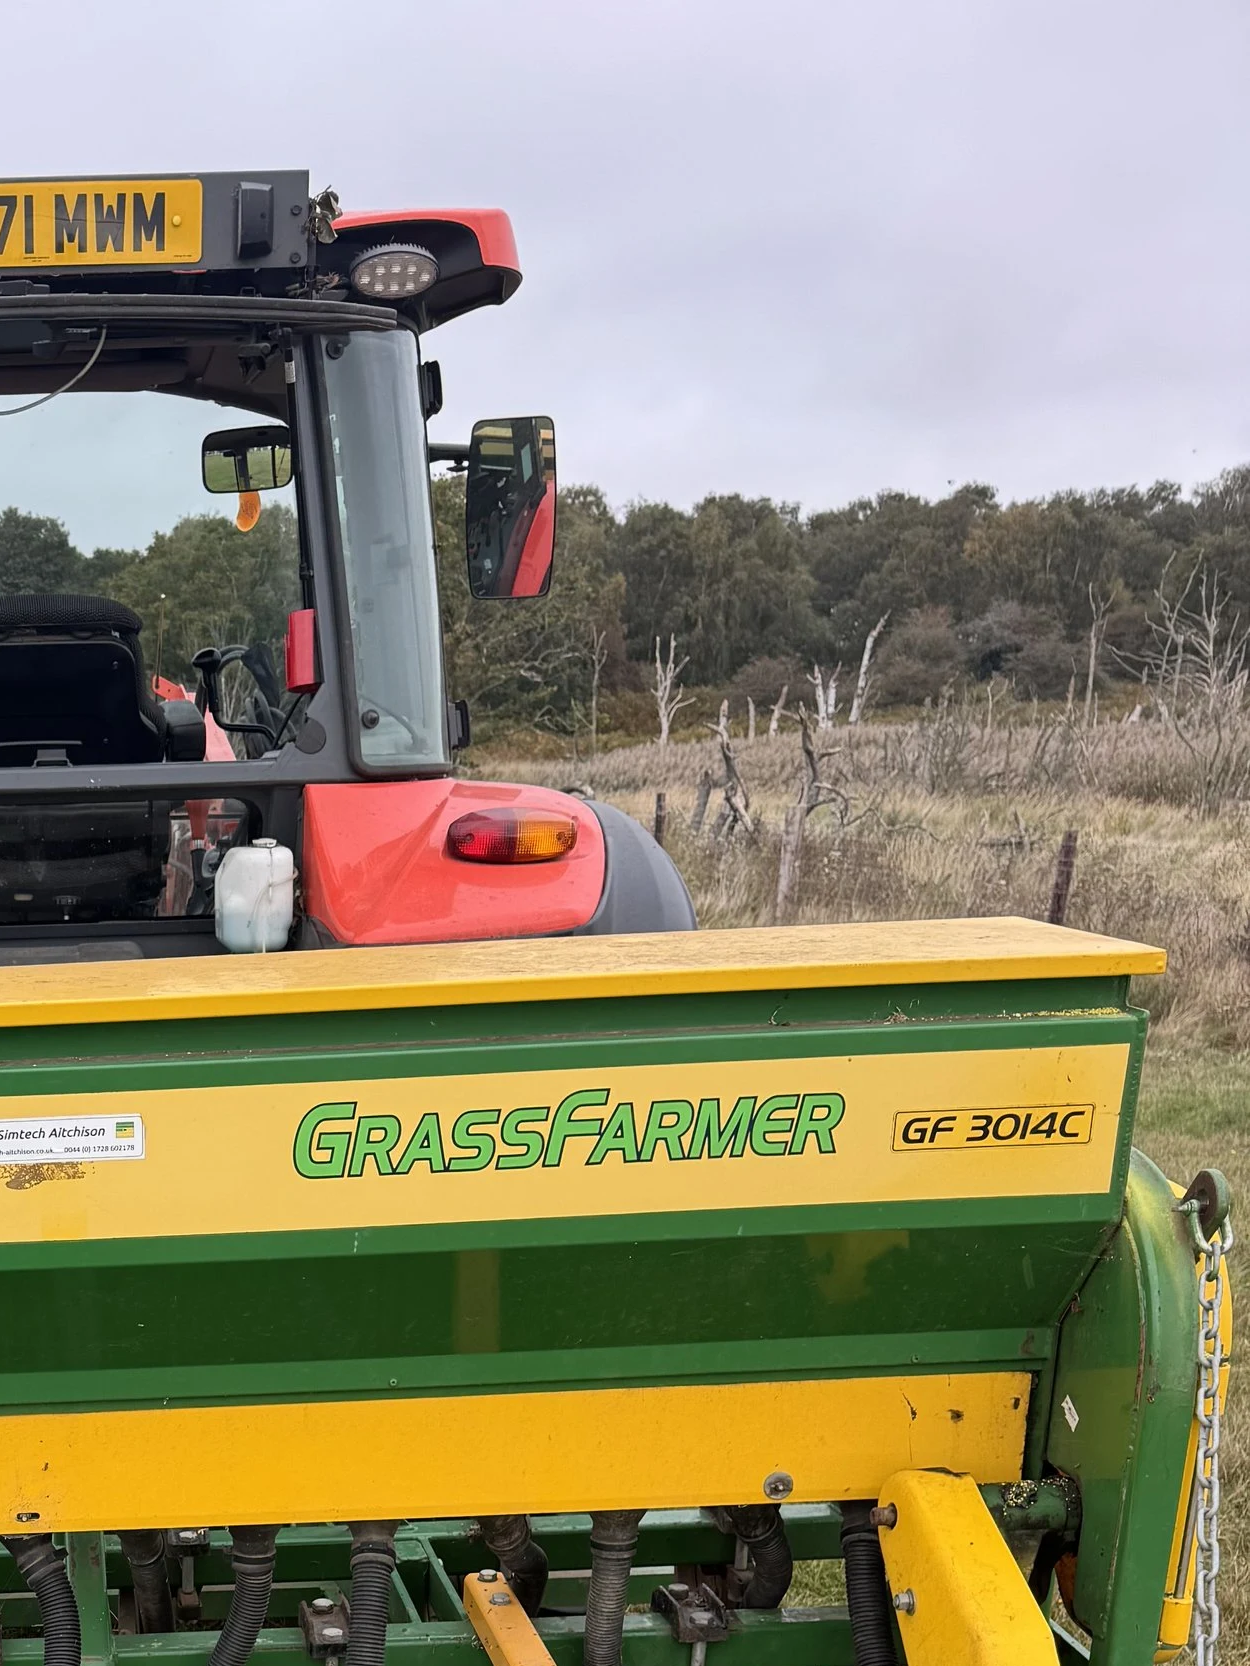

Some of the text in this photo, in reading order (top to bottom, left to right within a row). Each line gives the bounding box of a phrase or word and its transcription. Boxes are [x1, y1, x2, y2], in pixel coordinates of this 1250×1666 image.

[54, 191, 167, 254] MWM
[48, 1125, 106, 1139] Aitchison
[901, 1110, 1086, 1144] GF 3014C
